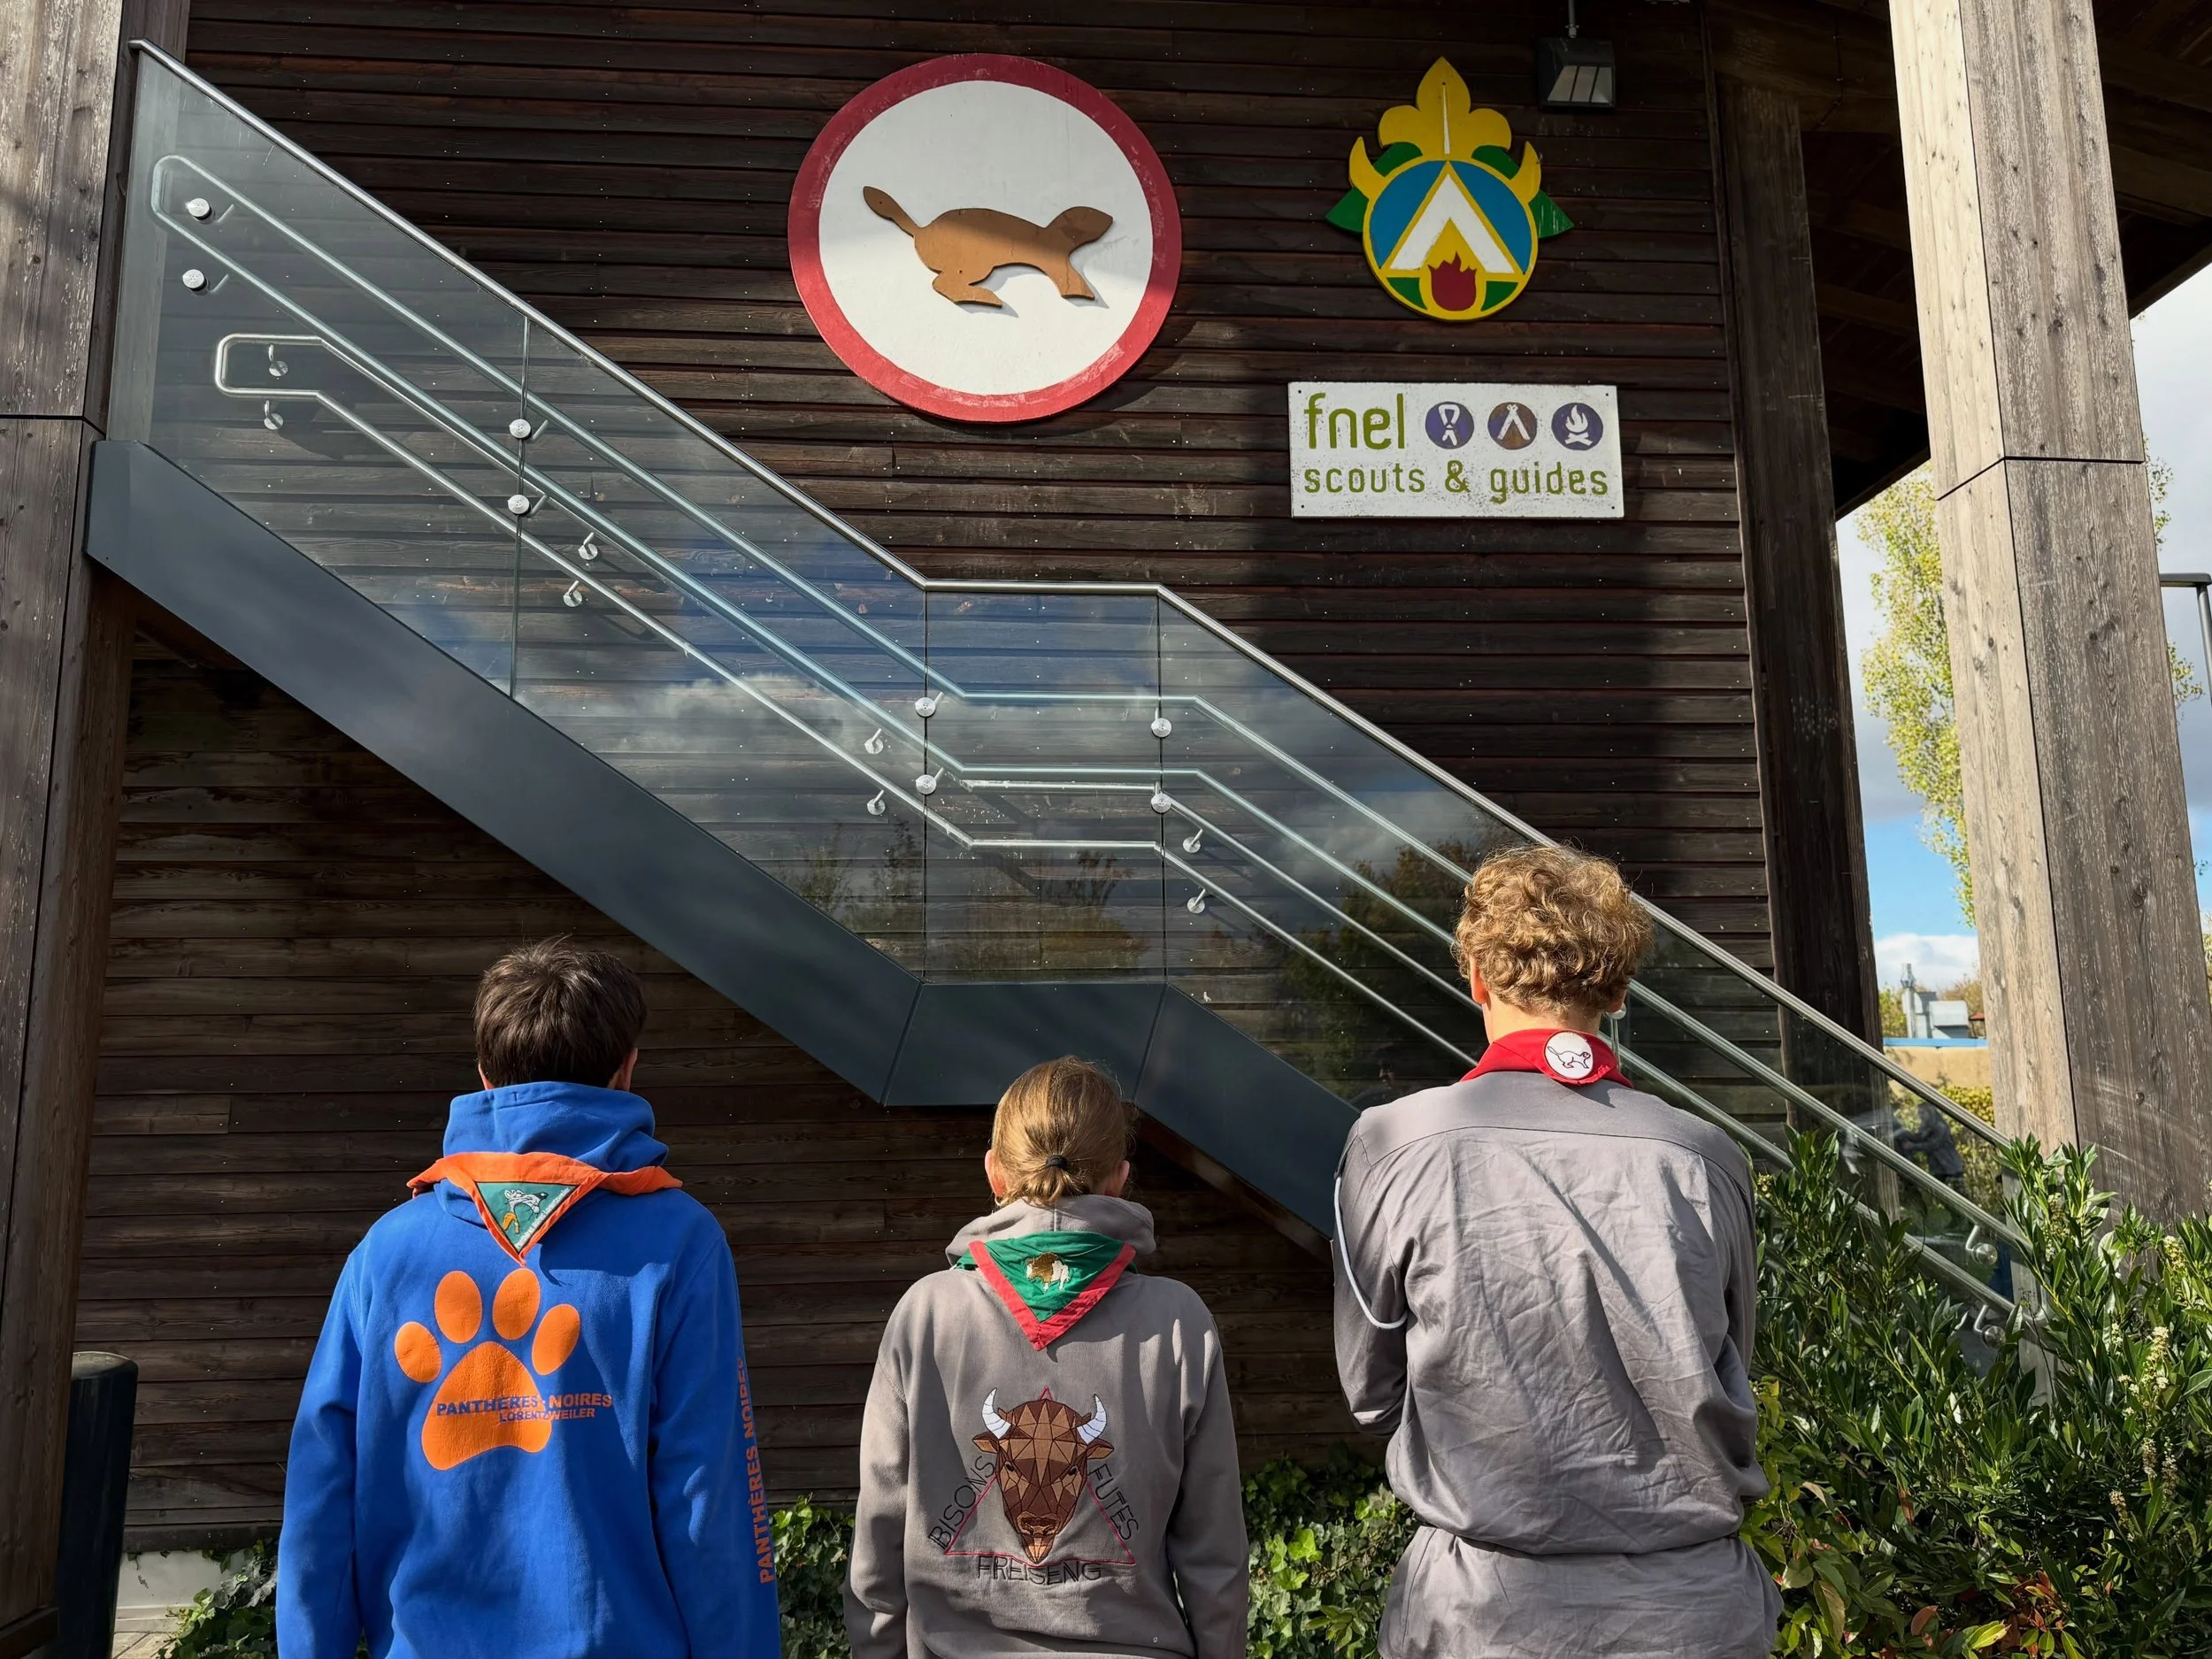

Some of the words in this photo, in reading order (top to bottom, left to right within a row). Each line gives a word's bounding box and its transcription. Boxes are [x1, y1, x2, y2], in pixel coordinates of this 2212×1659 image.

[1303, 392, 1404, 449] fnel
[1304, 463, 1425, 494] scouts
[1444, 459, 1471, 494] &
[1490, 461, 1609, 504] guides
[549, 1393, 612, 1409] NOIRES
[928, 1455, 995, 1549] BISONS
[977, 1555, 1102, 1585] FREISENG
